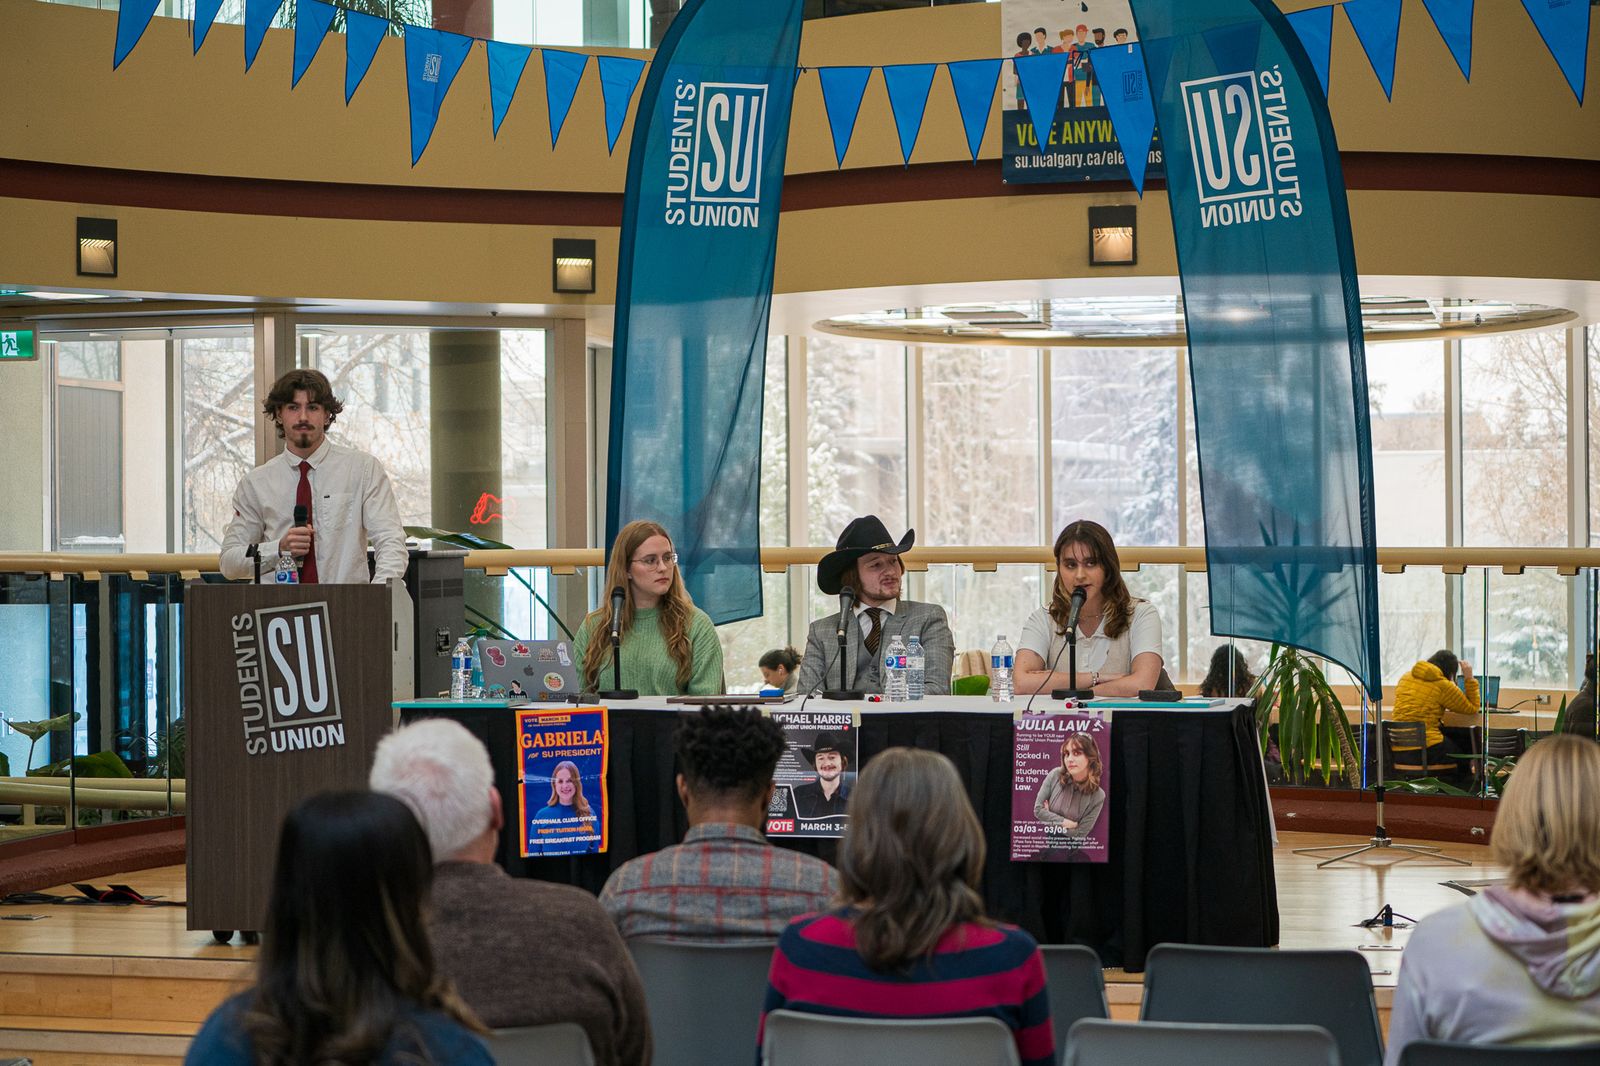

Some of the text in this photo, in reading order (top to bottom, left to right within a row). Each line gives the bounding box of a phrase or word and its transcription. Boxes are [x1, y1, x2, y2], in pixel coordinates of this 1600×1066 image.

[701, 93, 760, 192] SU
[665, 79, 696, 225] STUDENTS'
[690, 205, 759, 228] UNION
[267, 614, 328, 717] SU
[231, 613, 268, 755] STUDENTS
[772, 714, 851, 724] ICHAEL HARRIS
[1016, 719, 1090, 732] JULIA LAW
[270, 723, 345, 753] UNION
[520, 730, 604, 749] GABRIELA
[542, 750, 554, 758] SU
[555, 748, 602, 757] PRESIDENT
[1016, 743, 1030, 751] Still
[1015, 752, 1050, 760] locked in
[1015, 783, 1032, 791] Law.
[800, 823, 832, 831] MARCH
[1013, 824, 1037, 834] 03/03
[1044, 825, 1068, 835] 03/05
